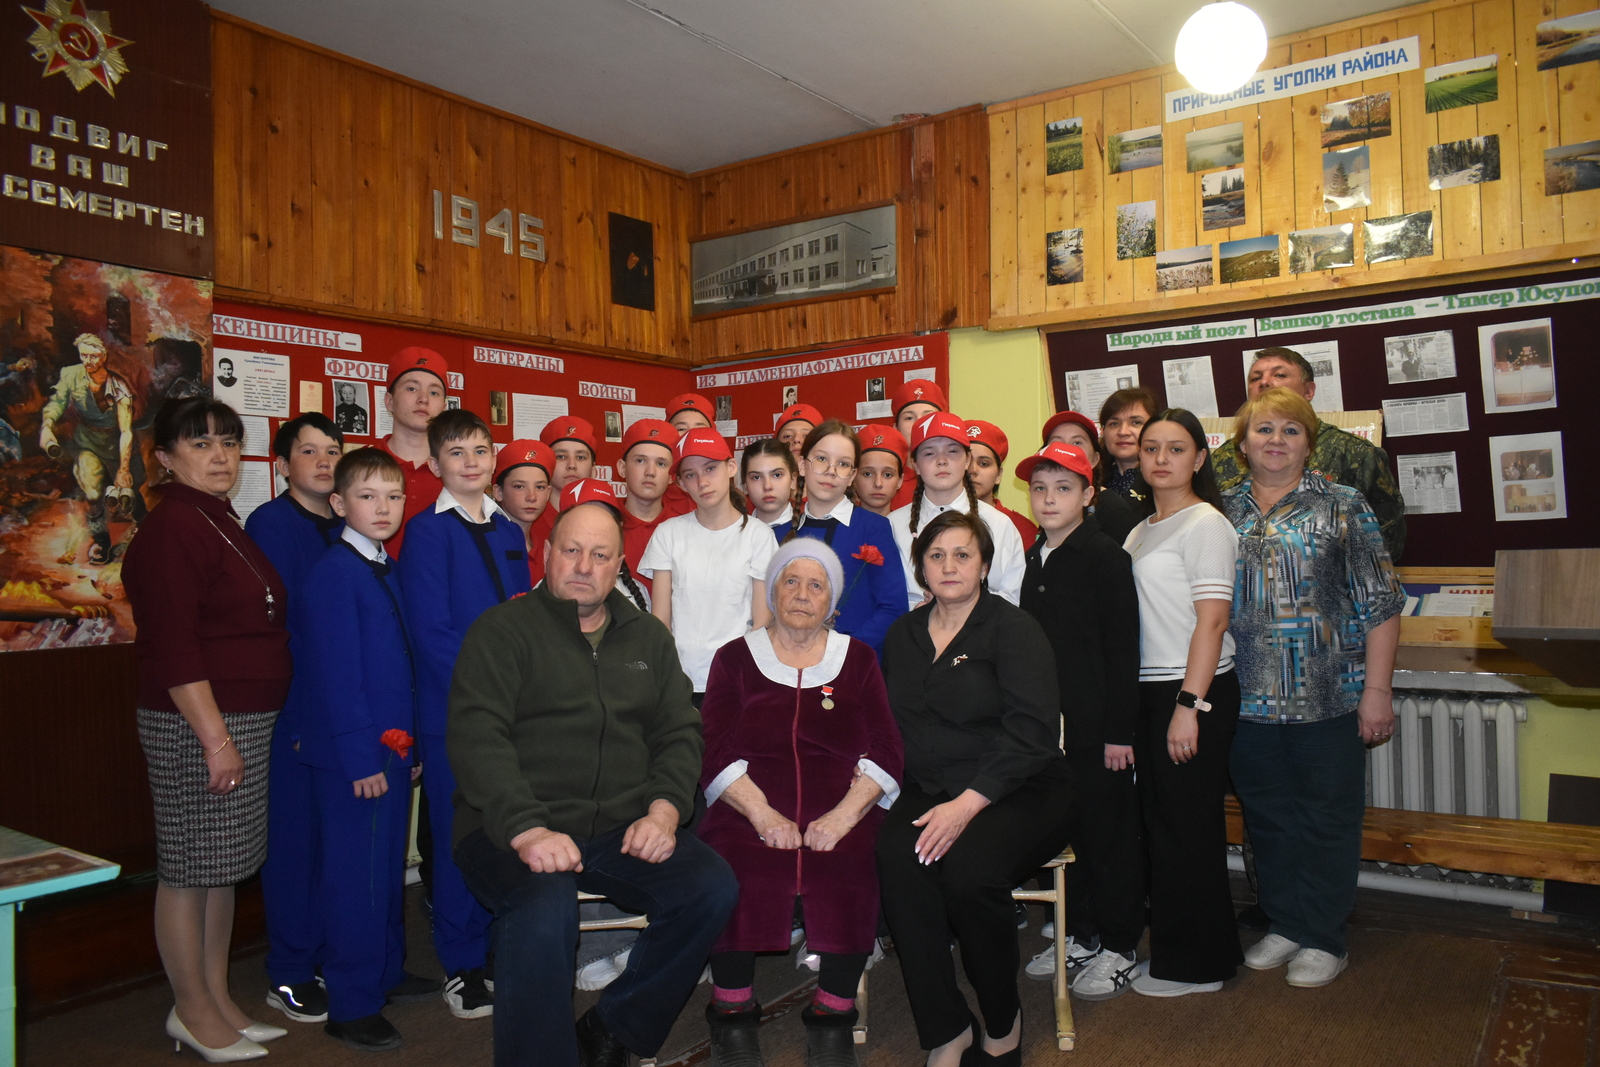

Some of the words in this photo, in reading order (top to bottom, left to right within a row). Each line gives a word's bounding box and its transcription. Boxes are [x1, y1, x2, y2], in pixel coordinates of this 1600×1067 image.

[1274, 64, 1336, 91] УГОЛКИ
[1342, 48, 1409, 76] РАЙОНА
[0, 102, 168, 161] ОДВИГ
[31, 144, 129, 188] ВАШ
[3, 174, 204, 237] ССМЕРТЕН
[433, 189, 546, 263] 1945
[213, 316, 341, 349] ЖЕНЩИНЫ
[1206, 324, 1247, 339] поэт
[1443, 290, 1514, 310] Тимер
[327, 359, 389, 381] ФРОН
[476, 347, 561, 373] ВЕТЕРАНЫ
[698, 375, 717, 388] ИЗ
[727, 364, 801, 386] ПЛАМЕНИ
[804, 346, 923, 375] АФГАНИСТАНА
[580, 381, 633, 402] ВОЙНЫ
